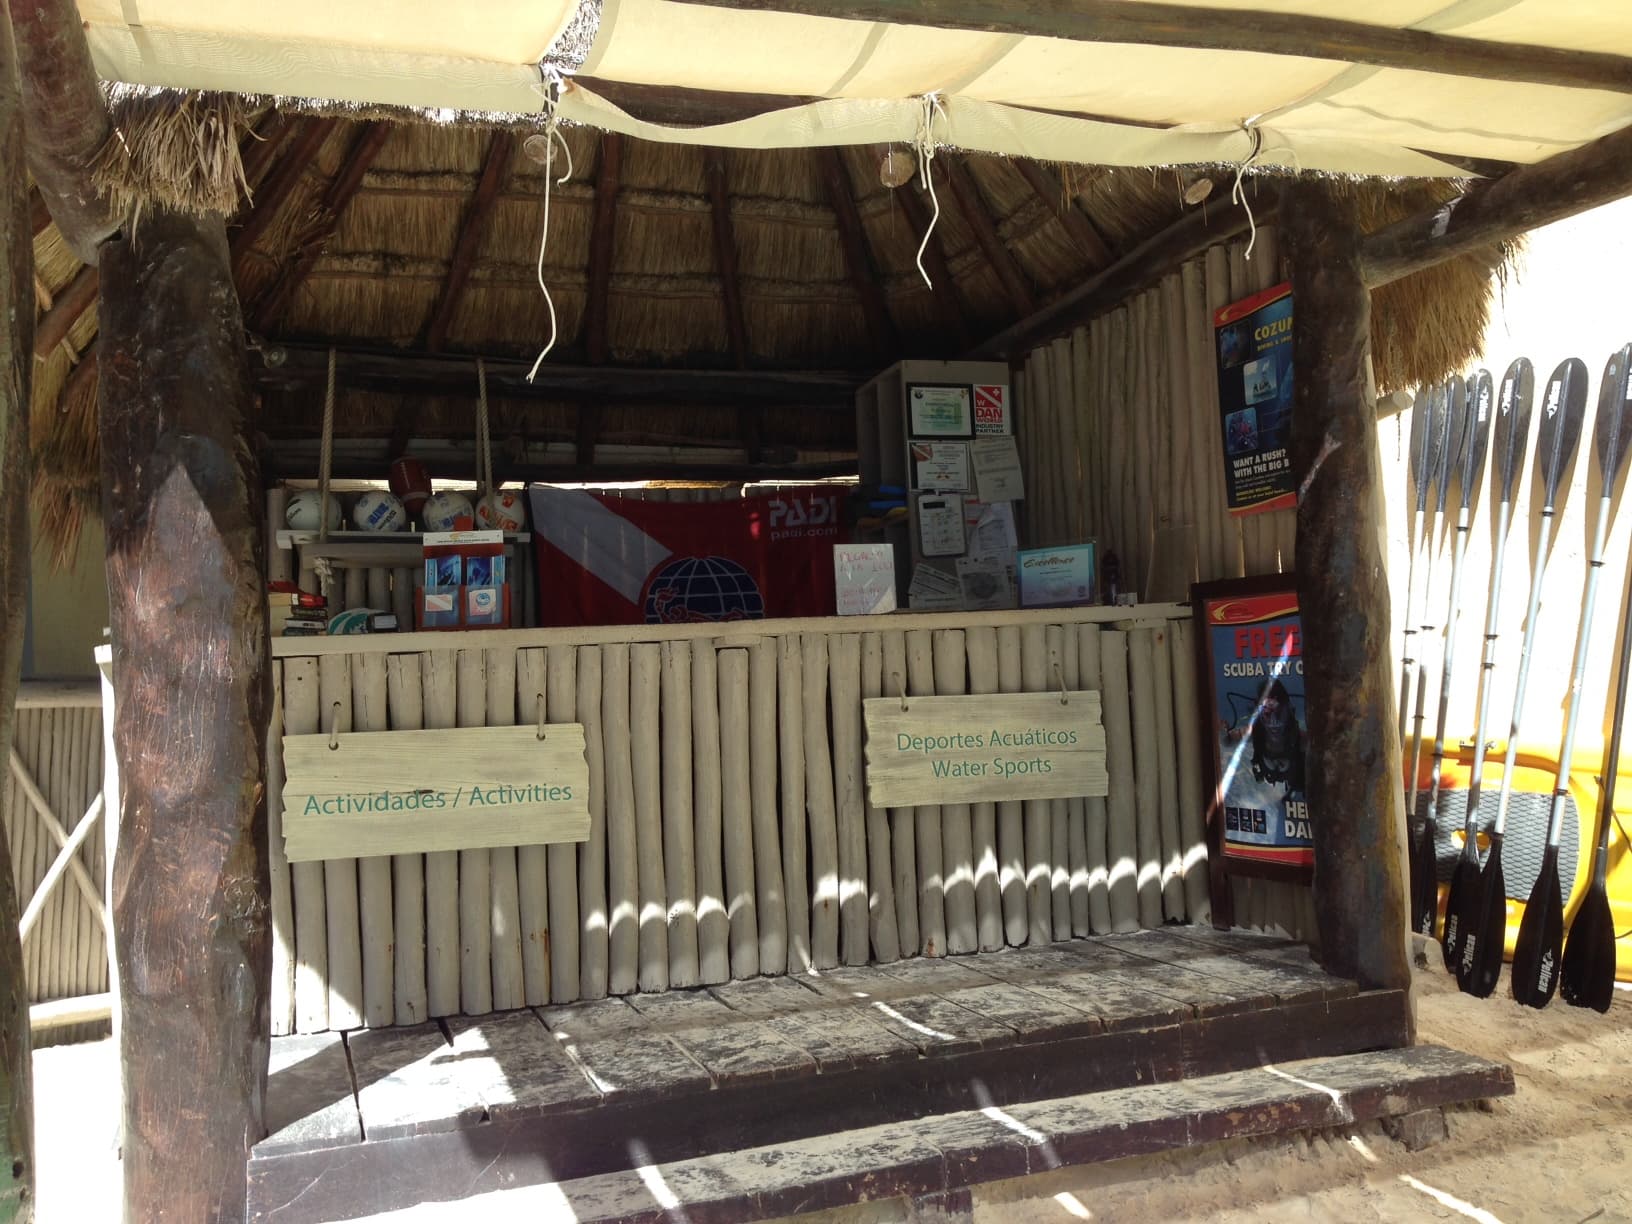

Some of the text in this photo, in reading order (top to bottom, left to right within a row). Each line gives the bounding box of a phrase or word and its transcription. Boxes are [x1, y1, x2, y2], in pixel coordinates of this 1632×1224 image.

[975, 408, 1003, 418] DAN
[1232, 448, 1287, 469] WANT A RUSH?
[1233, 467, 1253, 479] WITH
[1253, 463, 1268, 474] THE
[1268, 459, 1282, 471] BIG
[767, 496, 838, 528] PADI
[770, 527, 839, 544] padi.com
[1234, 624, 1303, 659] FREE
[1223, 661, 1265, 677] SCUBA
[1266, 660, 1292, 676] TRY
[897, 728, 1078, 753] Deportes Acuáticos
[931, 757, 1052, 778] Water Sports
[303, 783, 573, 815] Actividades / Activities
[1462, 933, 1477, 976] Pelican
[1538, 947, 1555, 994] Pelican
